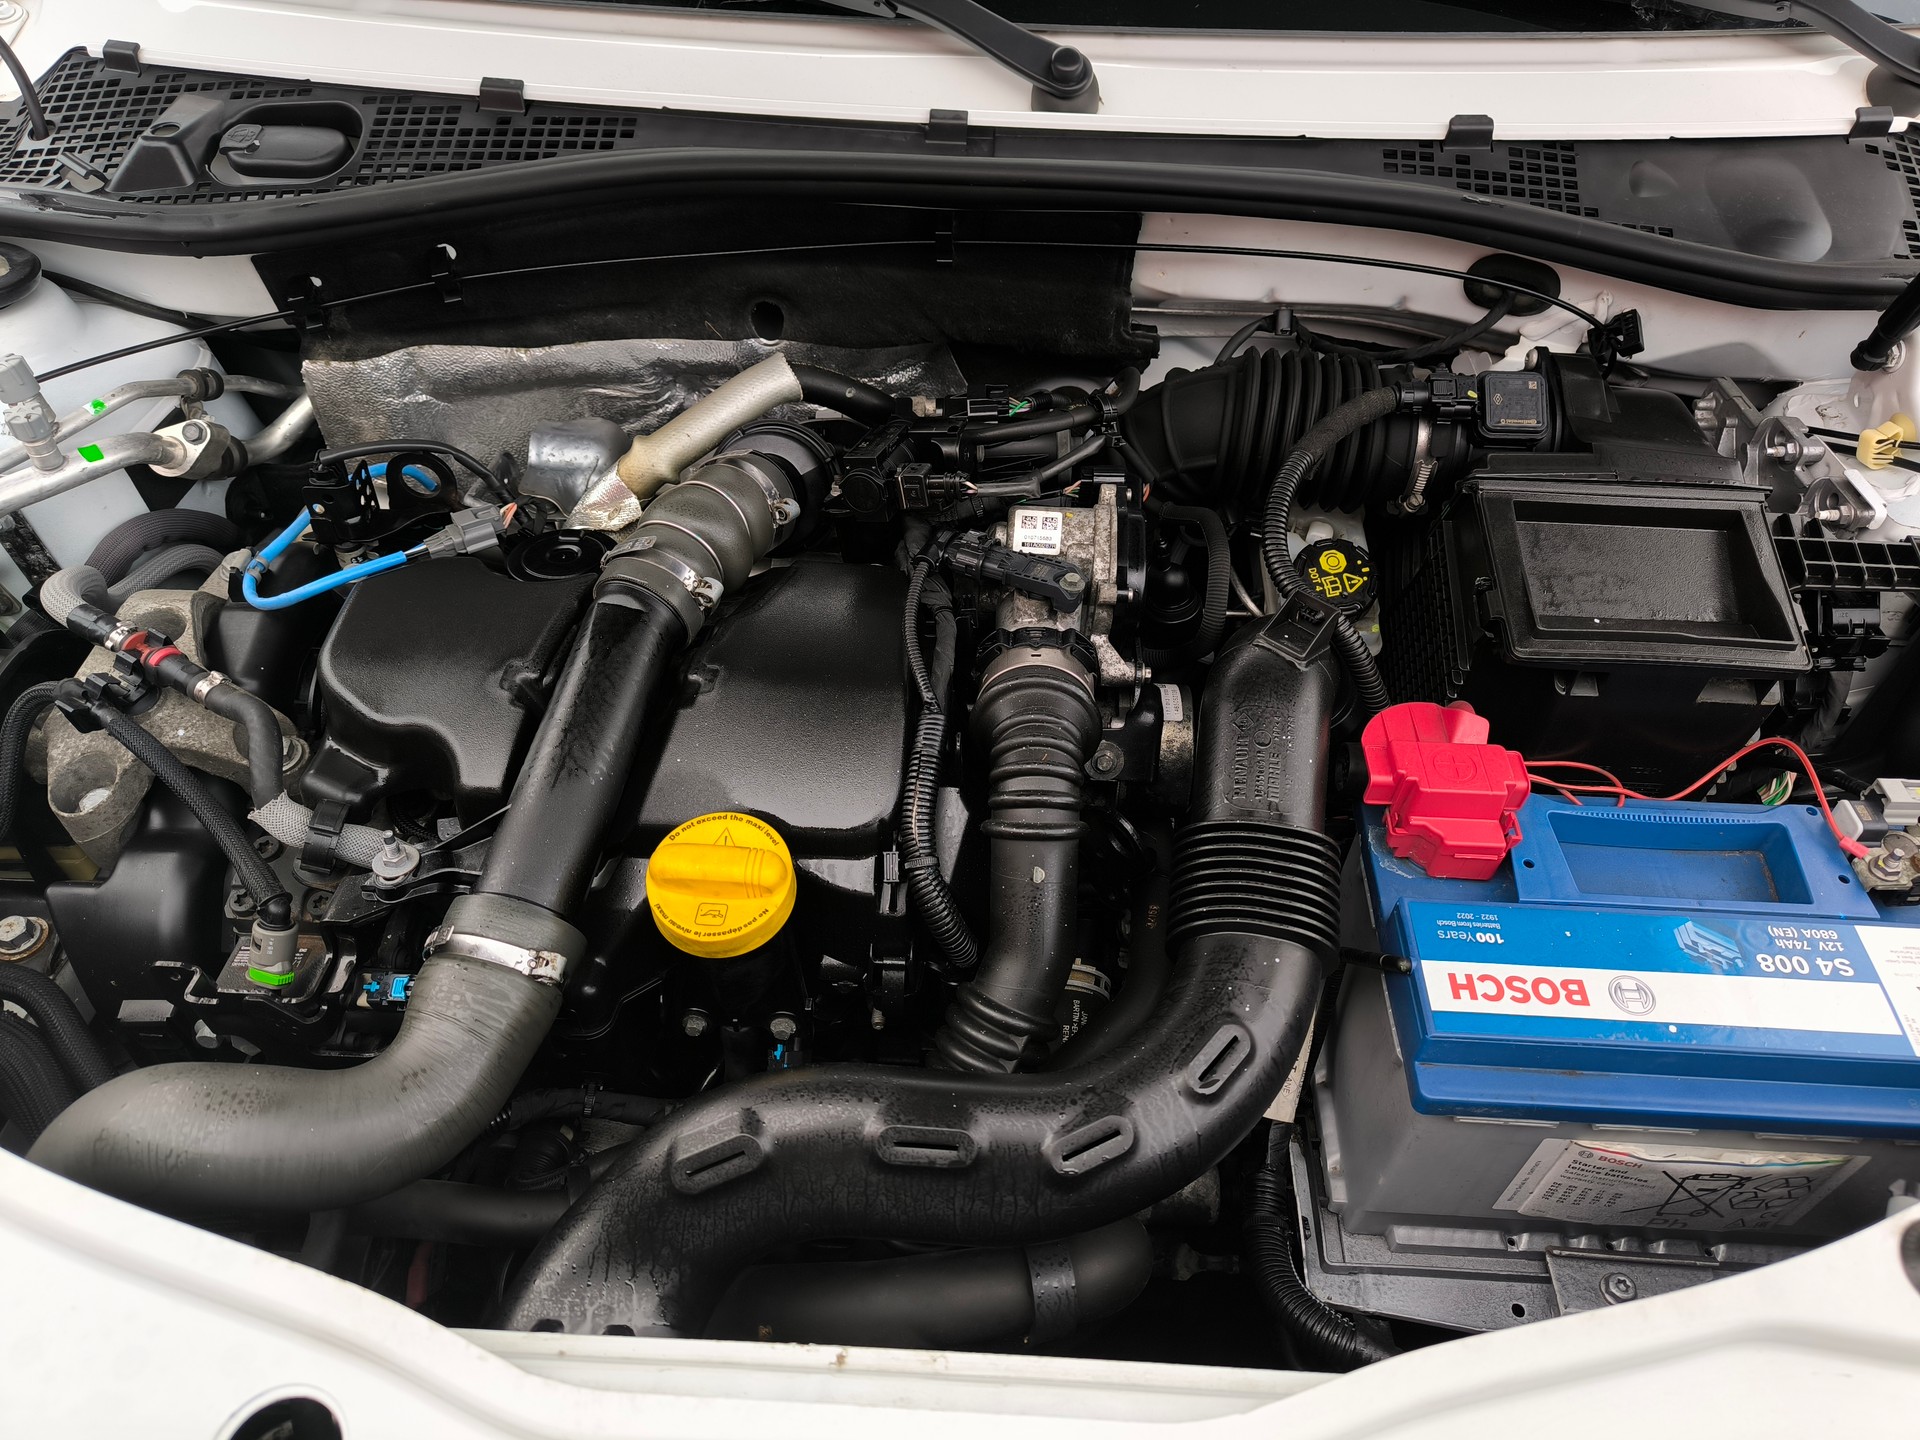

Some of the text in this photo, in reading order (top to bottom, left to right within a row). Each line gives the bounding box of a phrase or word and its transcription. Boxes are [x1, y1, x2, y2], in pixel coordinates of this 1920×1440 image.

[1308, 567, 1321, 583] DOT
[1232, 735, 1249, 799] RENAULT
[1267, 752, 1282, 802] MAHLE
[668, 814, 780, 847] Do not exceed the maxi level
[654, 903, 770, 938] Ne pas dépasser le niveau maxi
[1456, 912, 1475, 920] 2022
[1481, 913, 1499, 921] 1922
[1436, 919, 1502, 930] Batteries from Bosch
[1767, 924, 1838, 940] 680A (EN)
[1437, 929, 1505, 945] 100 Years
[1774, 937, 1844, 952] 12V 74Ah
[1755, 952, 1856, 977] S4 008
[1447, 972, 1591, 1007] BOSCH
[1072, 999, 1081, 1022] BARTIN
[1571, 1159, 1607, 1171] Starter
[1598, 1155, 1643, 1169] BOSCH
[1560, 1174, 1594, 1185] warranty
[1564, 1169, 1589, 1179] Safety
[1590, 1174, 1636, 1187] instructions
[1567, 1164, 1648, 1183] leisure batteries
